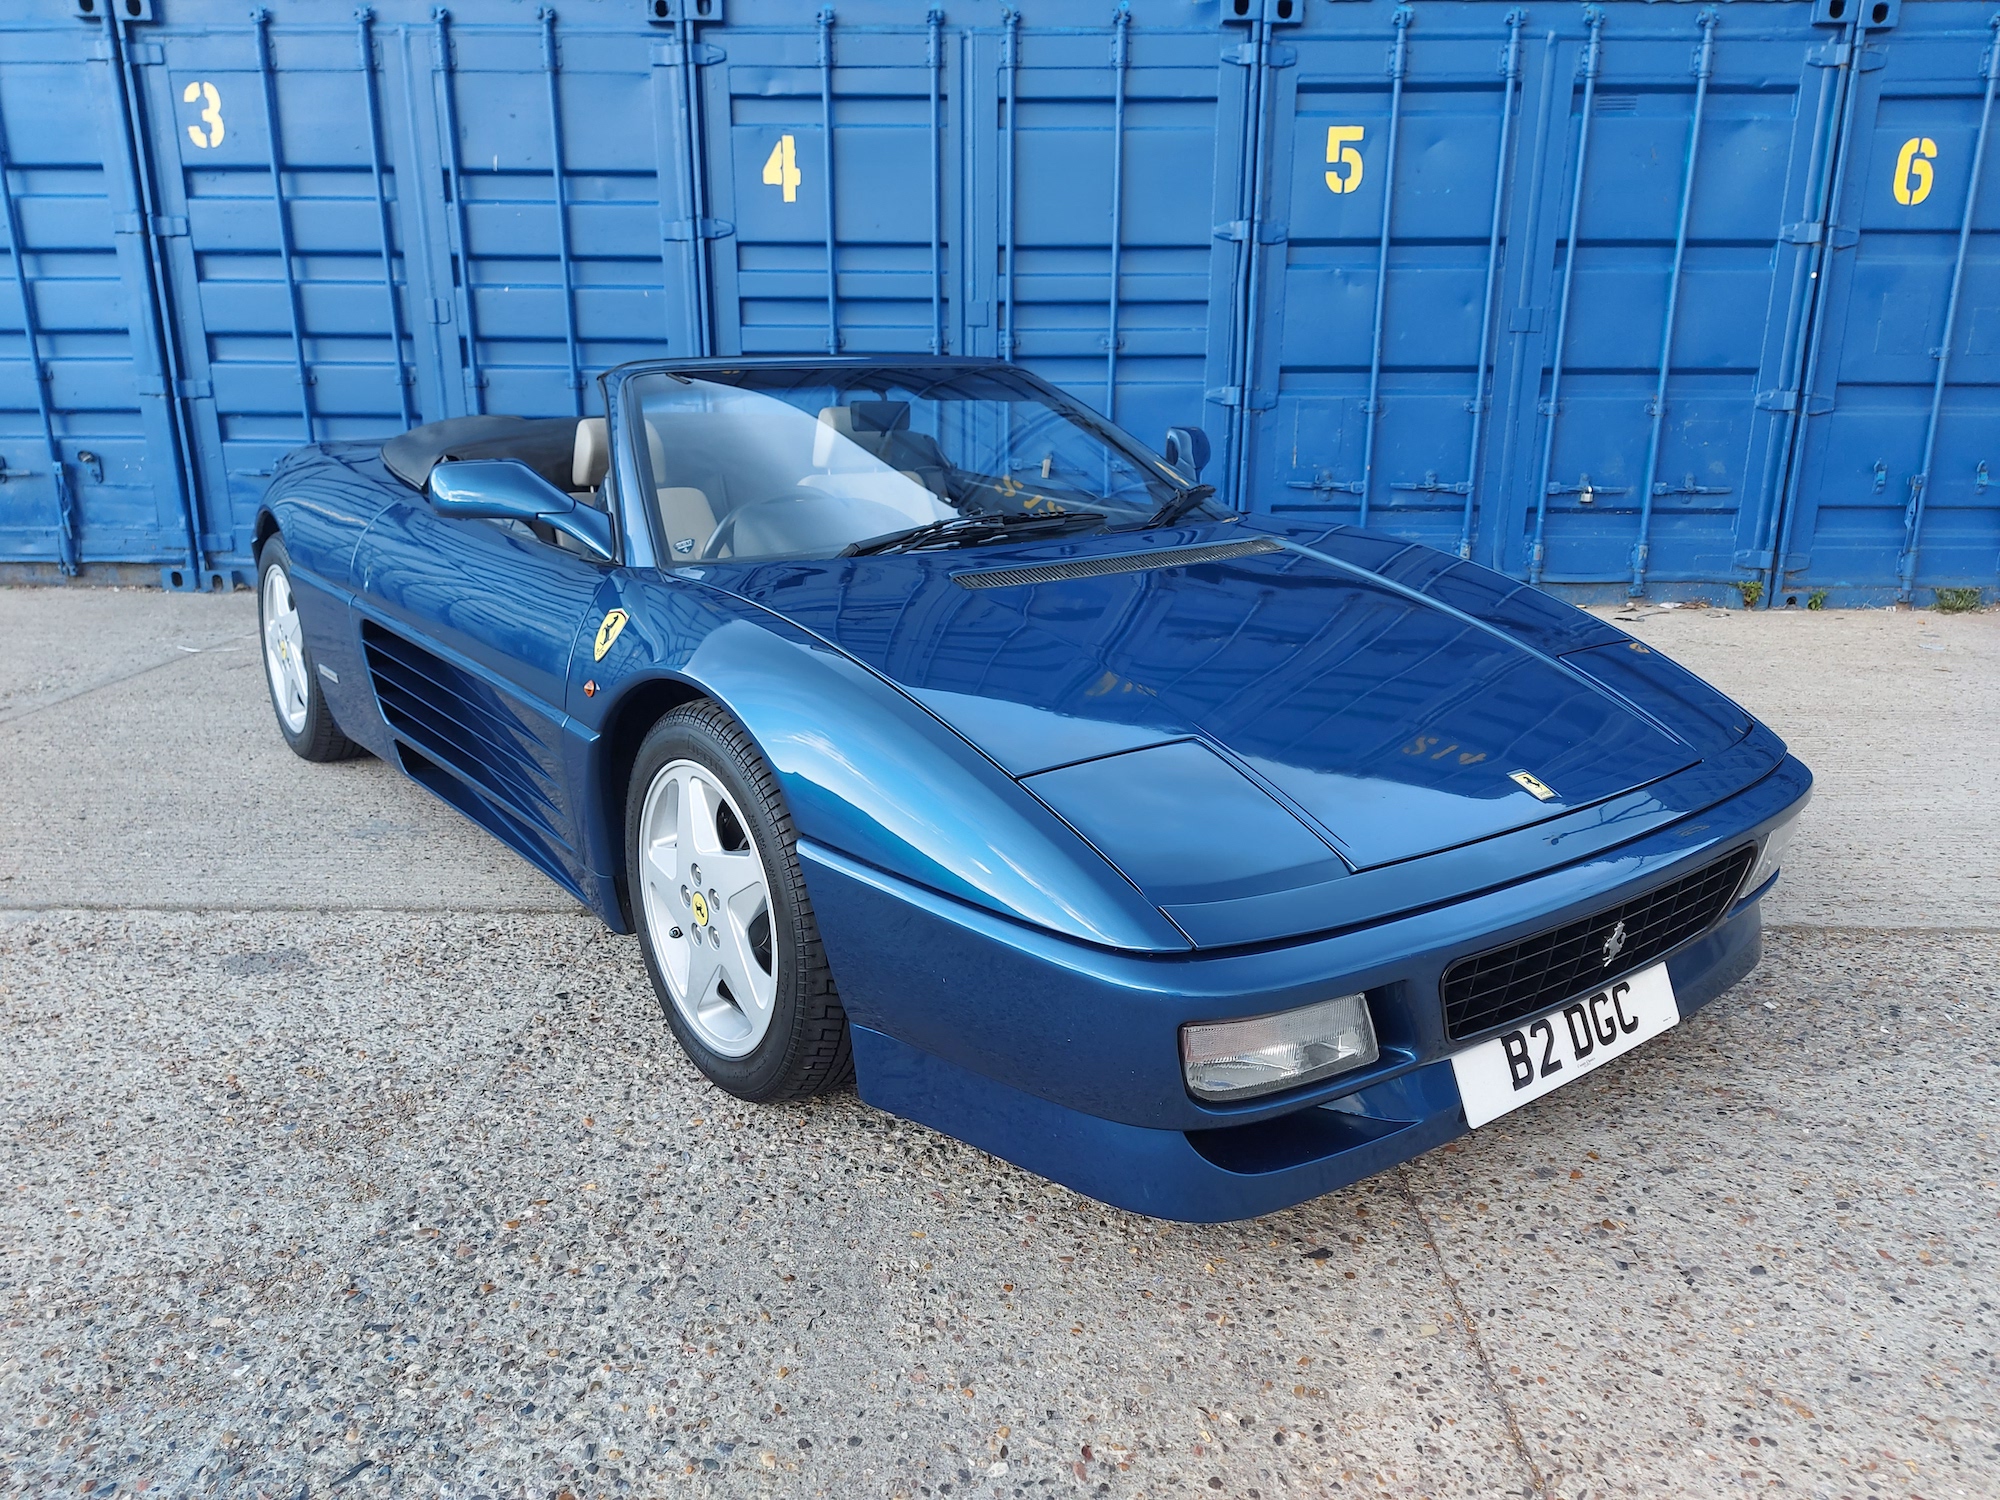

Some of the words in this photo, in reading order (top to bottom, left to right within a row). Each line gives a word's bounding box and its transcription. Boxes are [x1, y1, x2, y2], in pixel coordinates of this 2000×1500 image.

[183, 82, 225, 148] 3
[762, 135, 801, 203] 4
[1325, 126, 1365, 194] 5
[1893, 137, 1938, 205] 6
[1500, 1030, 1563, 1092] B2
[1563, 981, 1639, 1061] DGC
